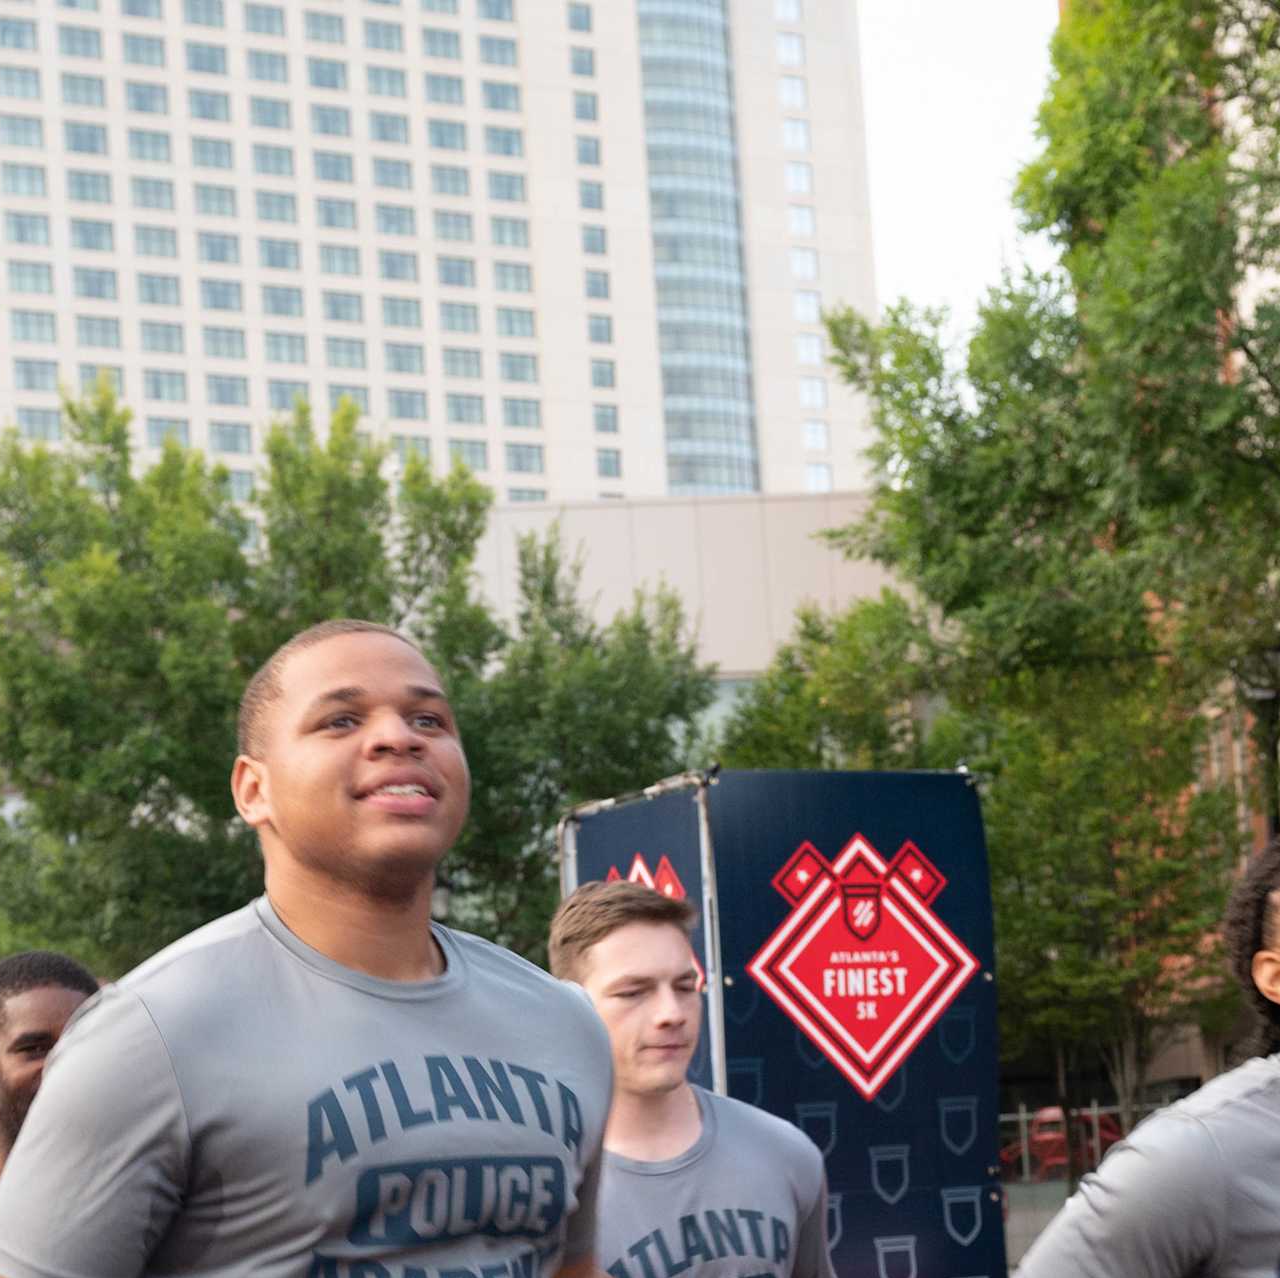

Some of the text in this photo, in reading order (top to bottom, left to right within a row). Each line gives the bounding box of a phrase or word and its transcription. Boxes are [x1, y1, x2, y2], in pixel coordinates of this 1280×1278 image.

[829, 950, 900, 964] ATLANTA'S
[823, 967, 909, 997] FINEST
[856, 1001, 878, 1020] 5K
[304, 1055, 585, 1188] ATLANTA
[369, 1164, 555, 1239] POLICE
